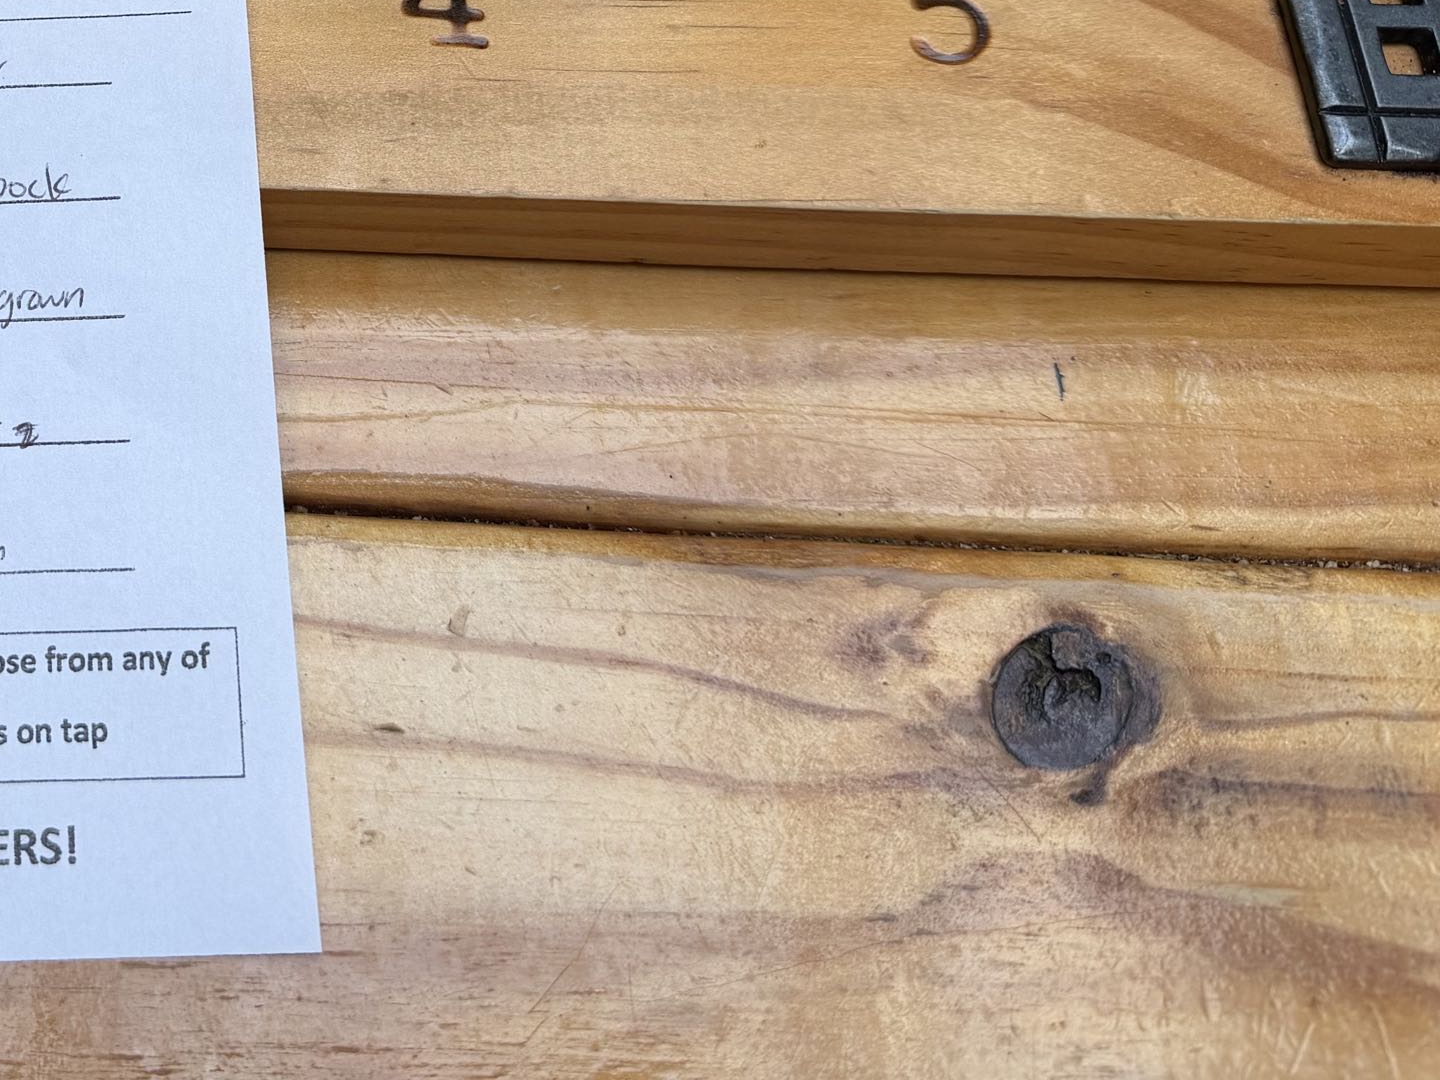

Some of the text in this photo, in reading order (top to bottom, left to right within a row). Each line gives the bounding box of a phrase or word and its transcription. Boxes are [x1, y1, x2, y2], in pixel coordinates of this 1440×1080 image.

[45, 644, 114, 673] from
[122, 648, 172, 676] any
[181, 641, 210, 670] of
[16, 722, 52, 744] on
[62, 718, 109, 749] tap
